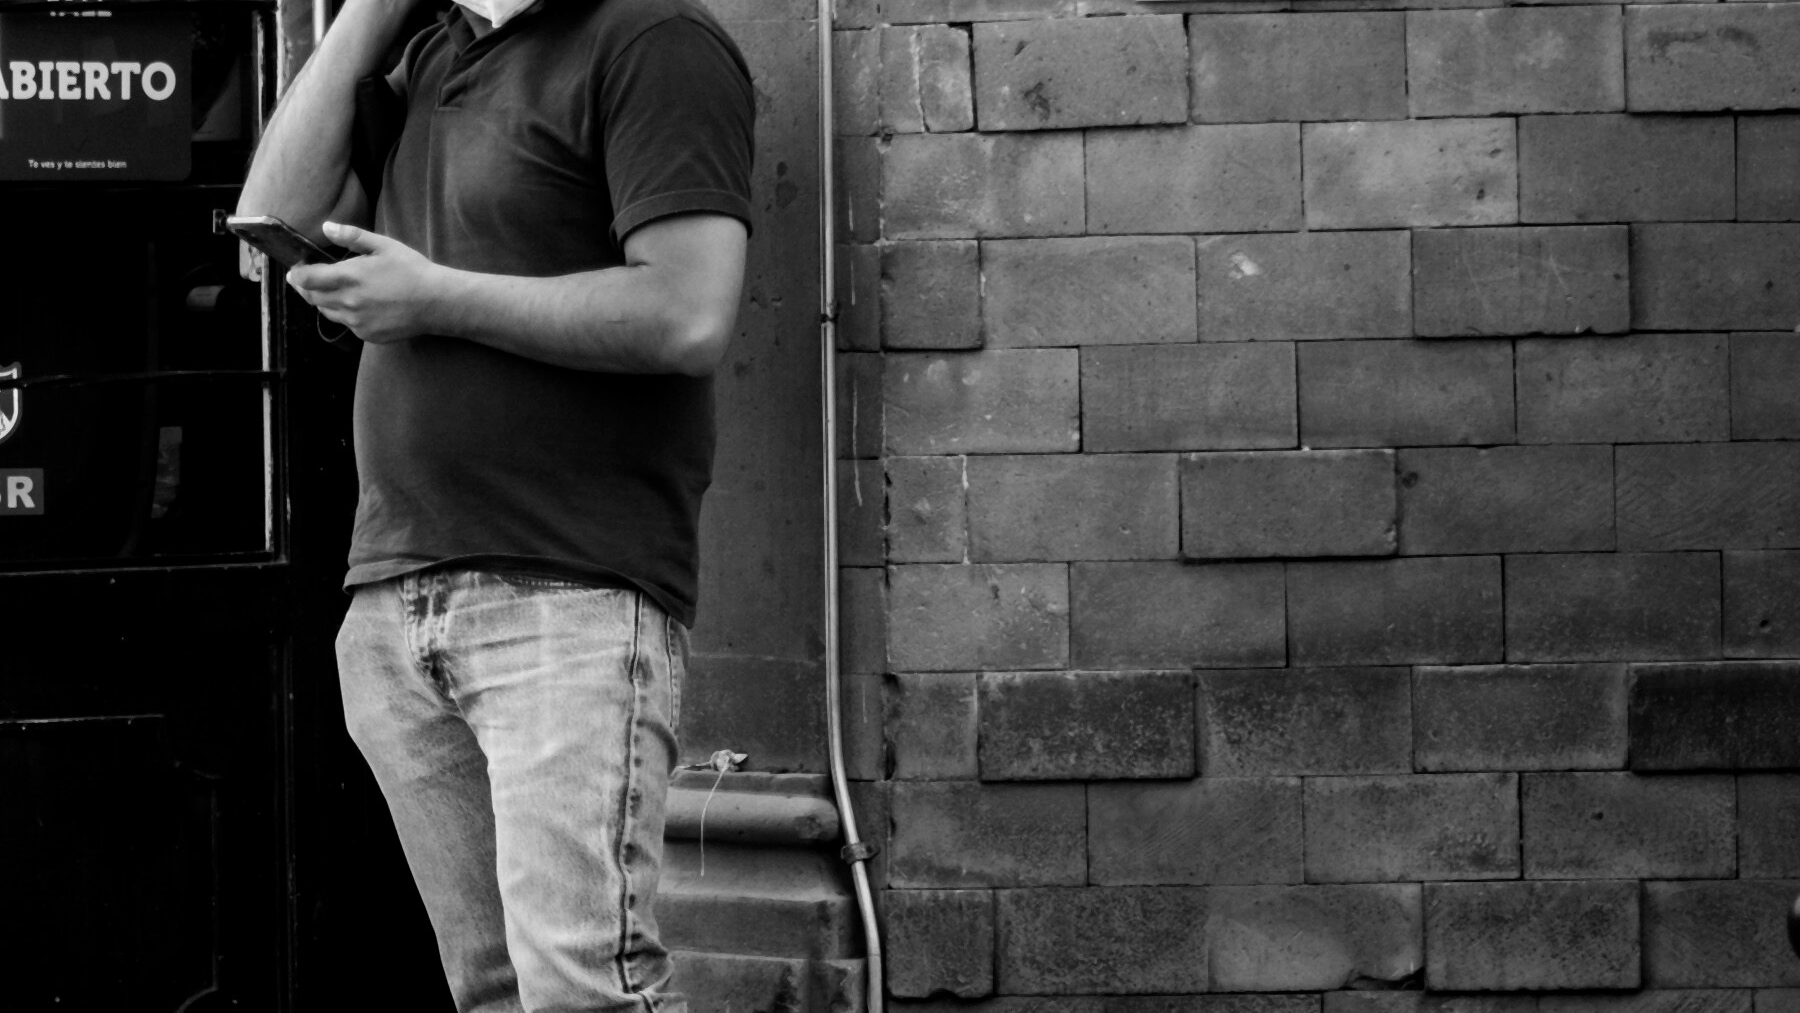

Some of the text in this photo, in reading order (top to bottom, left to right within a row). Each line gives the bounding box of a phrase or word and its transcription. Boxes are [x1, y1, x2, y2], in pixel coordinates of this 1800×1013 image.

[28, 159, 39, 169] Te
[57, 161, 63, 171] y
[64, 160, 74, 169] te
